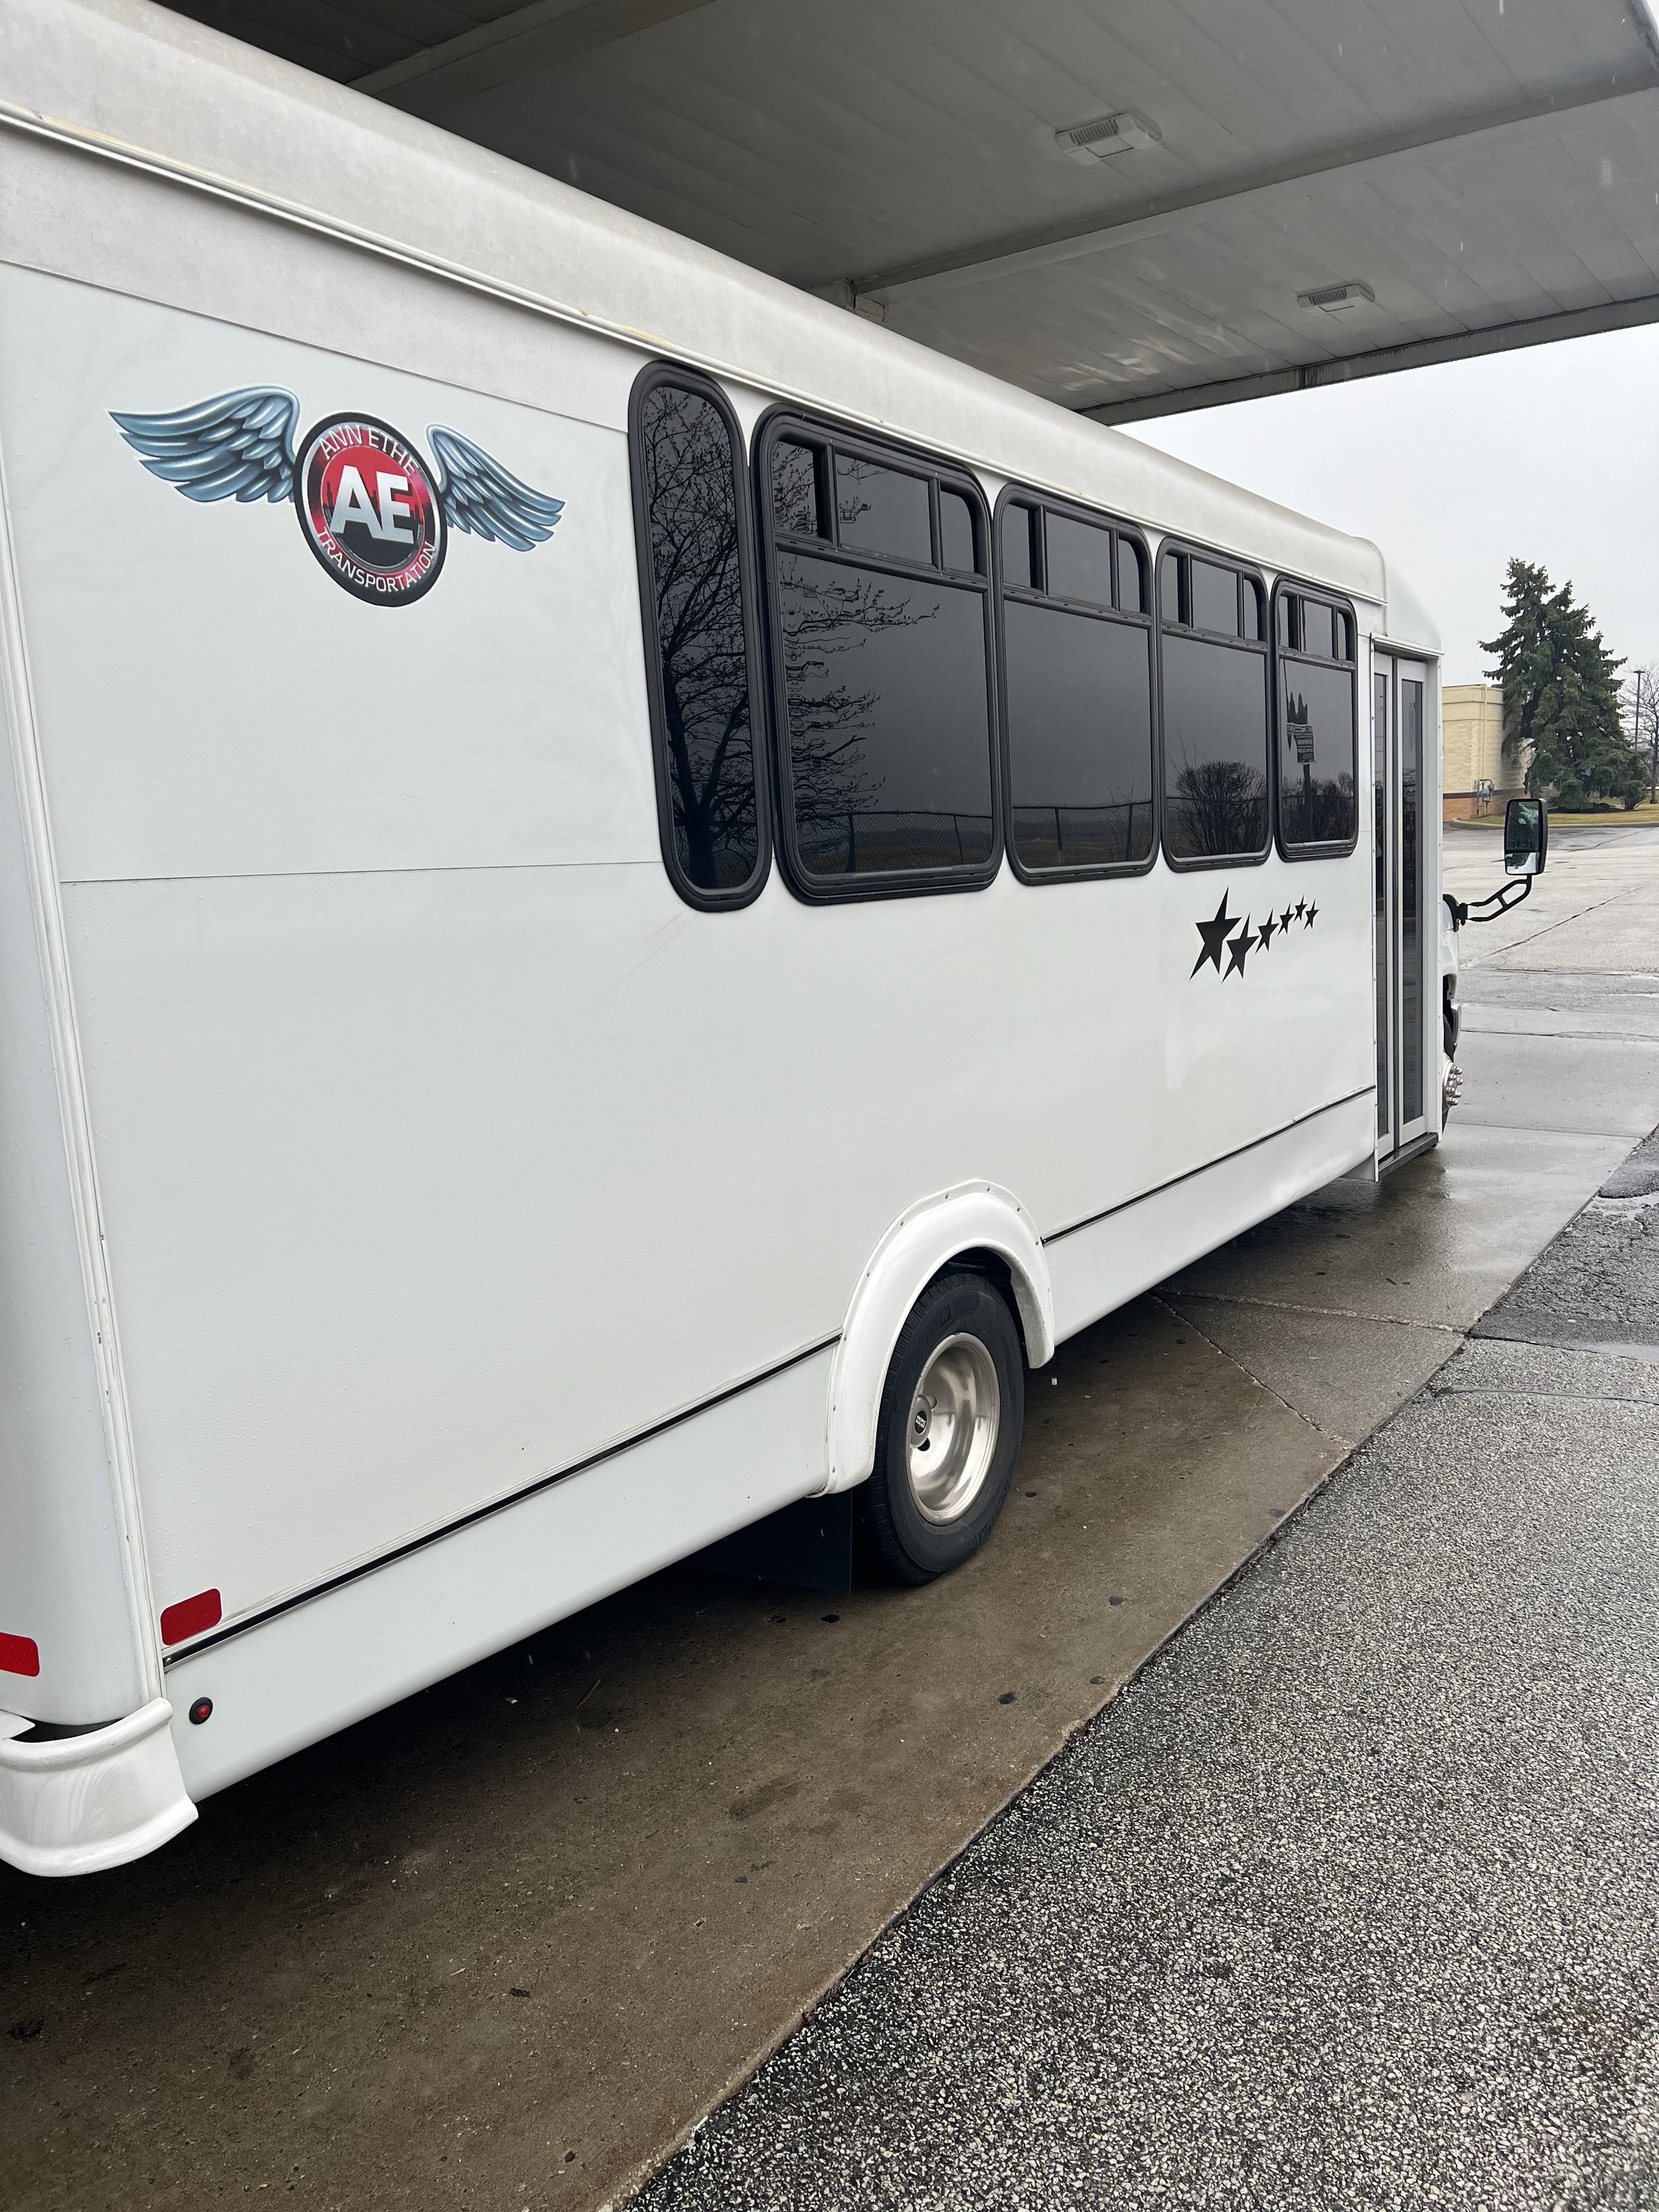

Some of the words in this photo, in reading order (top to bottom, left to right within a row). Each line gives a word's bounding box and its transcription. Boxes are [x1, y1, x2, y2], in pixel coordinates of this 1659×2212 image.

[319, 425, 362, 460] ANN
[330, 465, 414, 544] AE
[317, 527, 435, 592] TRANSPORTATION
